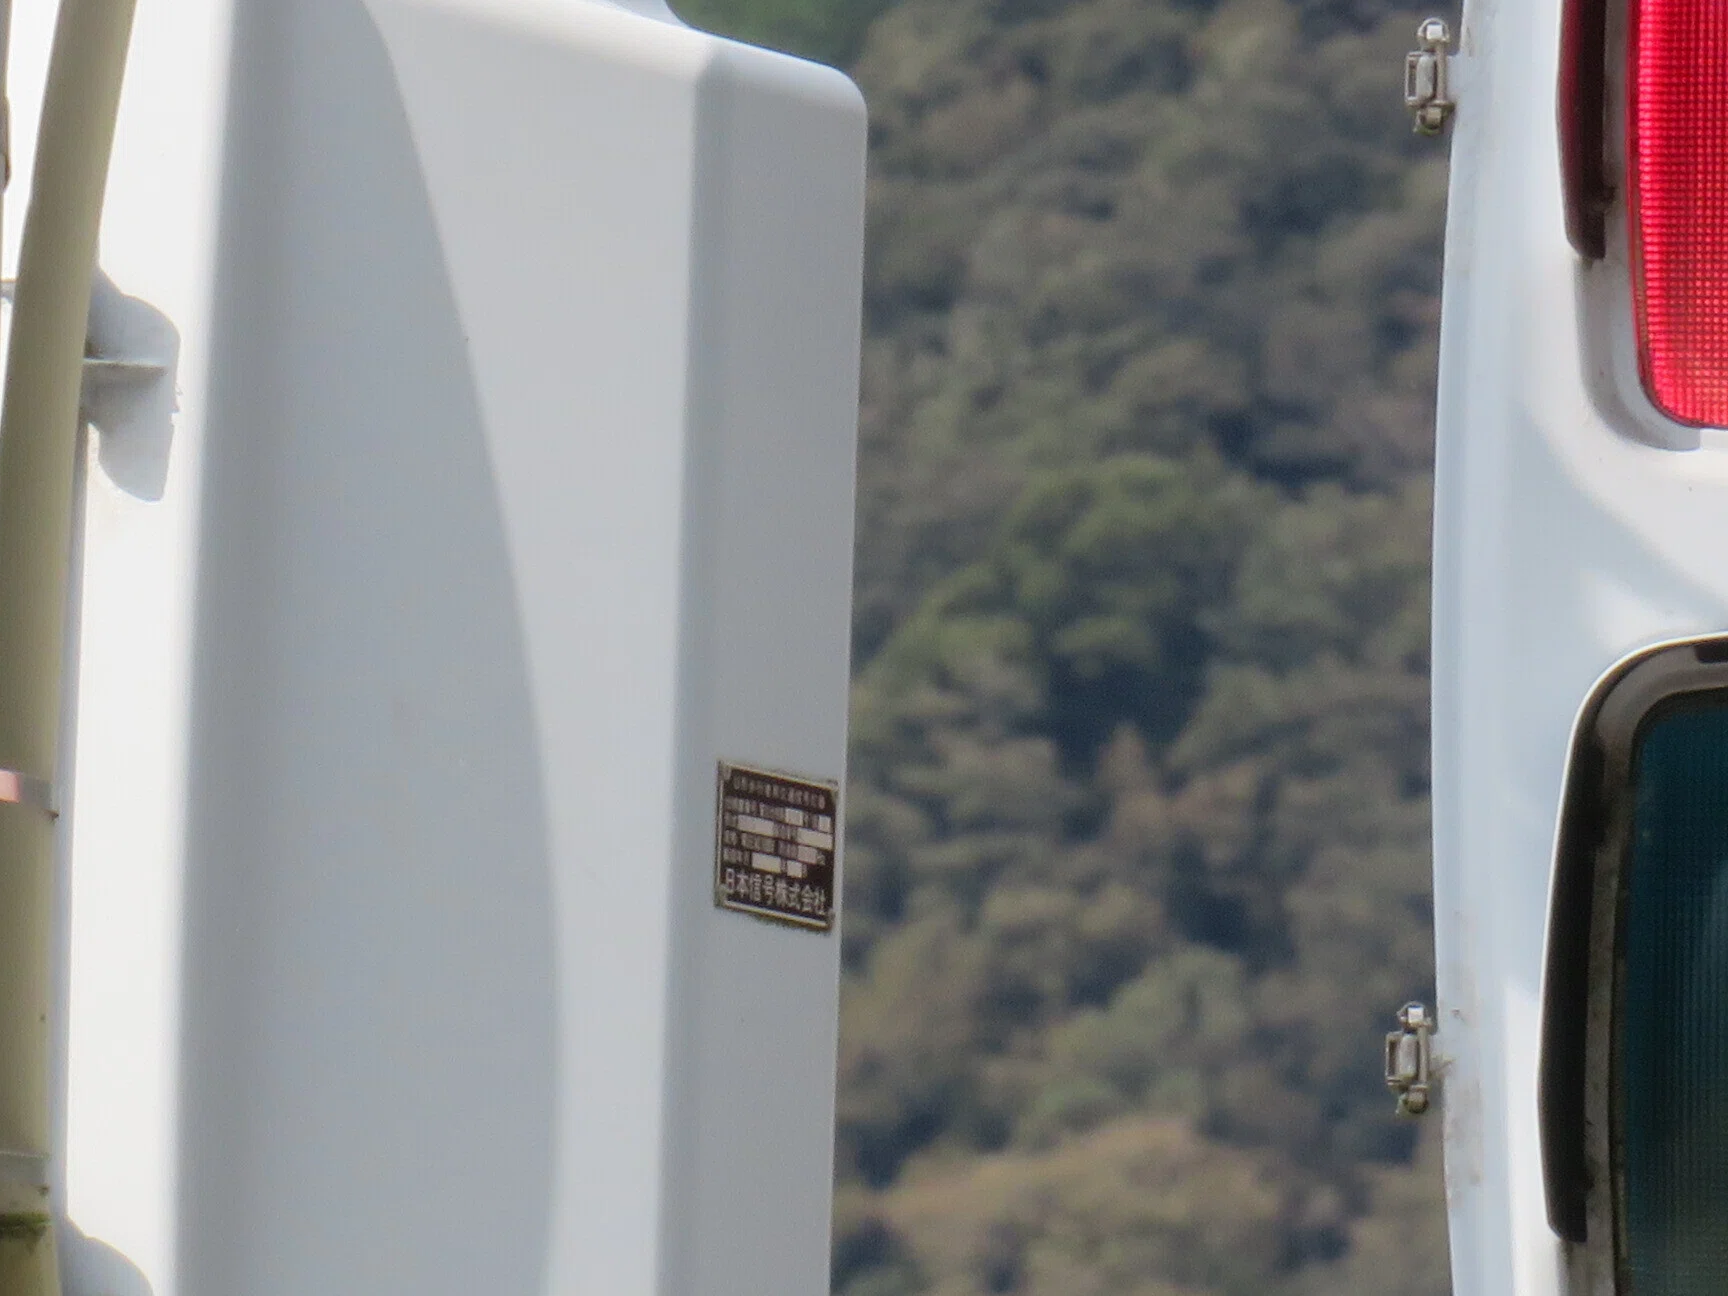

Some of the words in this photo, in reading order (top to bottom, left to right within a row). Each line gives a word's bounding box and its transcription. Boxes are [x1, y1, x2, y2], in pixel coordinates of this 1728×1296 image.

[725, 868, 826, 916] 日本信号株式会社
